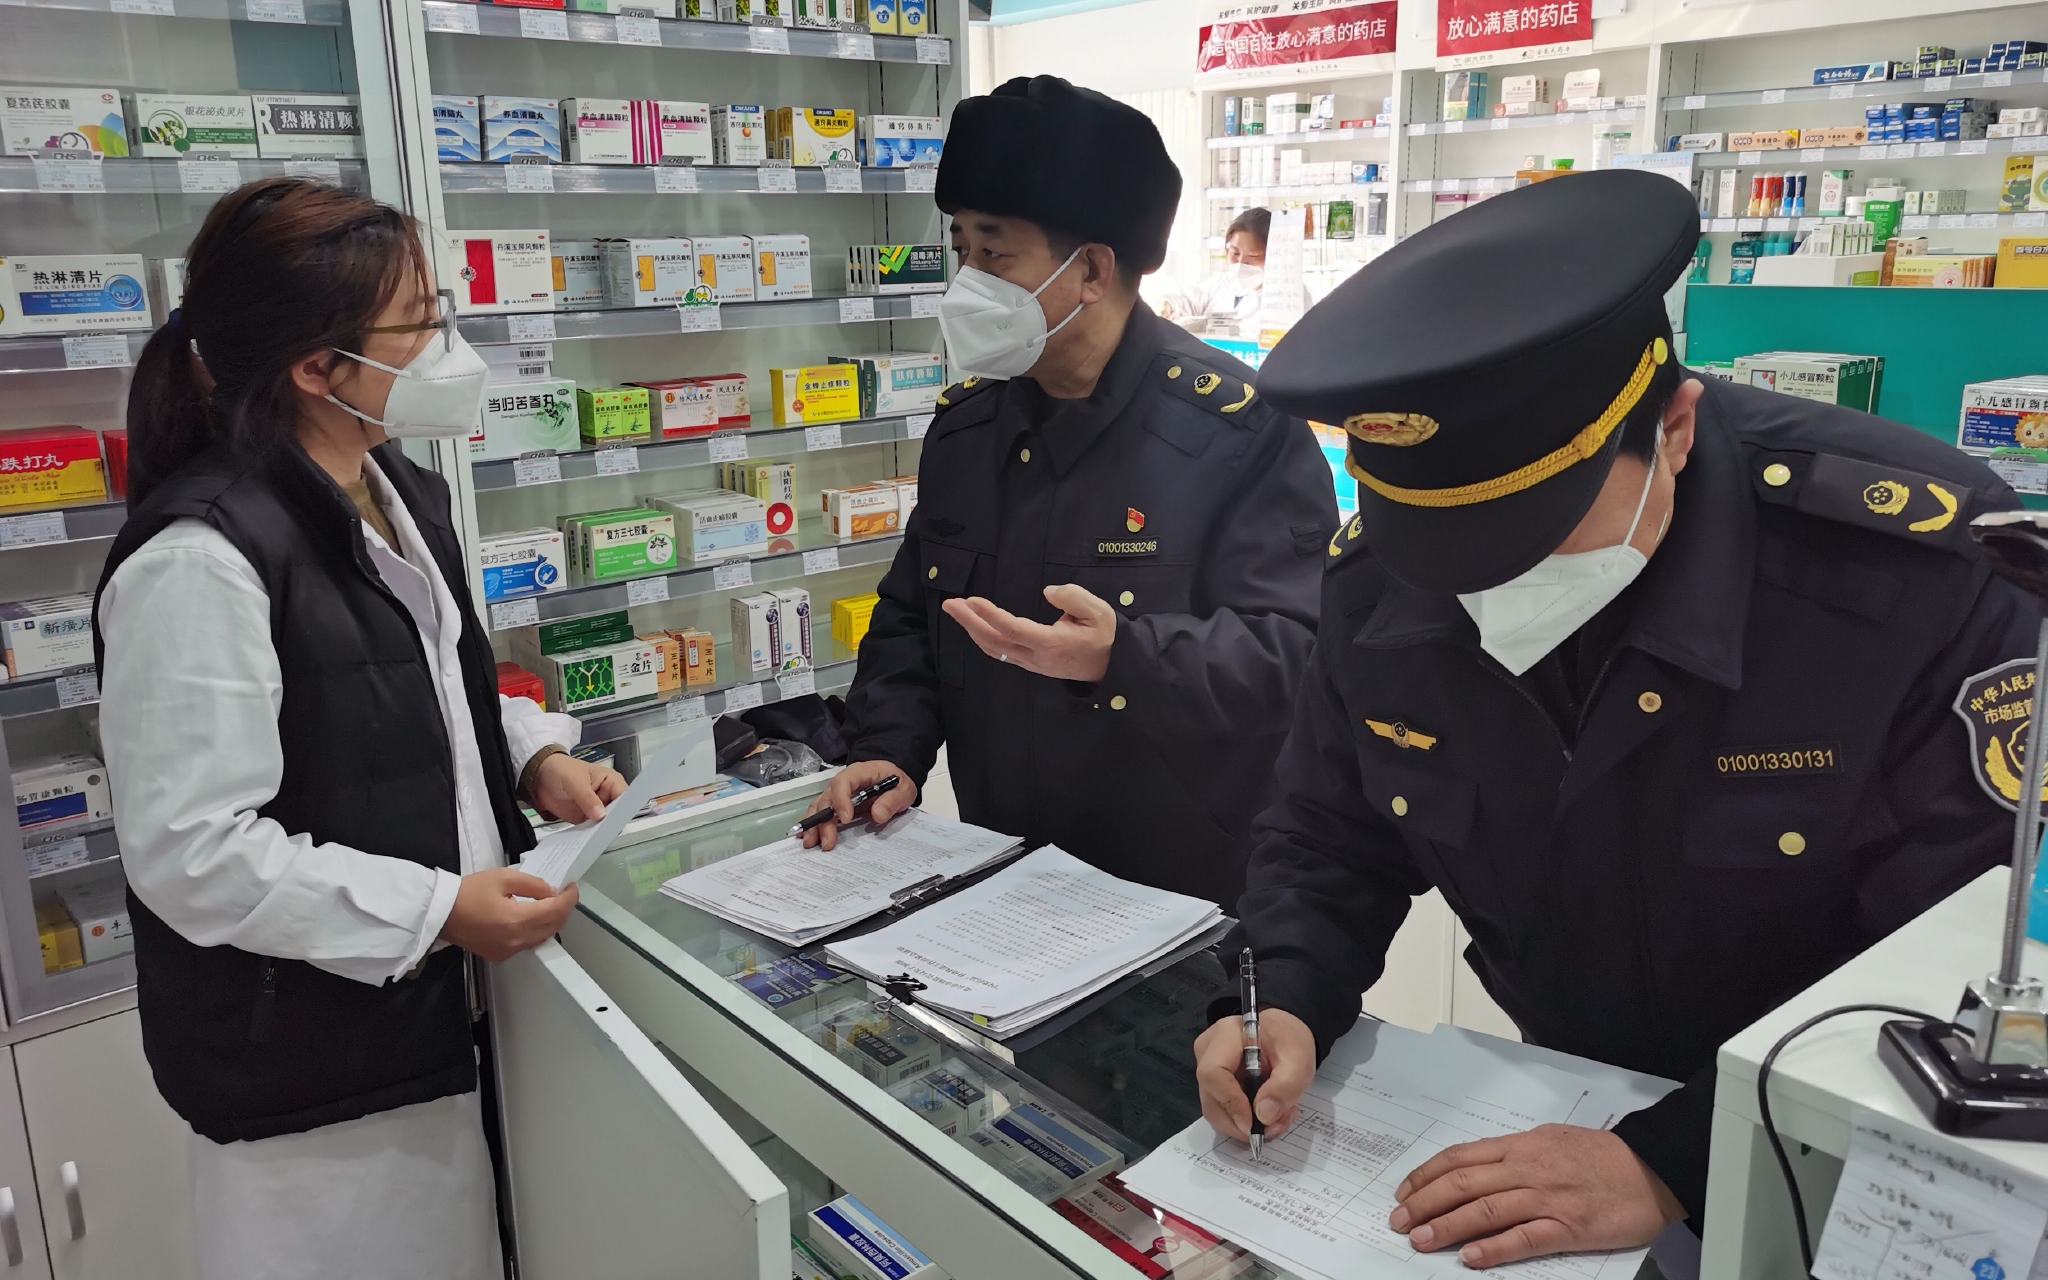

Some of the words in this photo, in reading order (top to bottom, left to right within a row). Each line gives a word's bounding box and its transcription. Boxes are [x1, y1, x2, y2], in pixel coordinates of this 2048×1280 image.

[1447, 2, 1579, 40] 放心满意的药店
[6, 97, 71, 110] 夏荔芪胶囊
[185, 106, 246, 118] 银花泌炎灵片
[503, 110, 545, 120] 养血清脑丸
[581, 112, 630, 122] 养血清脑颗粒
[663, 114, 708, 124] 养血清脑颗粒
[814, 118, 849, 127] 通窍鼻炎颗粒
[888, 122, 932, 131] 通窍鼻炎片
[497, 243, 546, 251] 丹溪玉屏风颗粒
[716, 253, 751, 261] 丹溪玉屏风颗粒
[33, 270, 103, 284] 热淋清片
[895, 367, 936, 381] 肤痒颗粒
[1780, 371, 1834, 383] 小儿感冒颗粒
[804, 380, 851, 391] 金蝉止痒颗粒
[488, 394, 554, 413] 当归苦参丸
[0, 453, 64, 471] 跌打丸
[782, 469, 793, 500] 沈阳红药
[699, 511, 738, 524] 活血止痛胶囊
[607, 525, 648, 540] 复方三七胶囊
[1098, 541, 1157, 553] 01001330246
[481, 549, 537, 565] 复方三七胶囊
[618, 660, 652, 676] 三金片
[671, 652, 679, 681] 三七片
[705, 648, 714, 676] 三七片
[1717, 750, 1834, 773] 01001330131
[16, 785, 74, 804] 肠胃康颗粒
[847, 1232, 891, 1268] 阿莫西林胶囊
